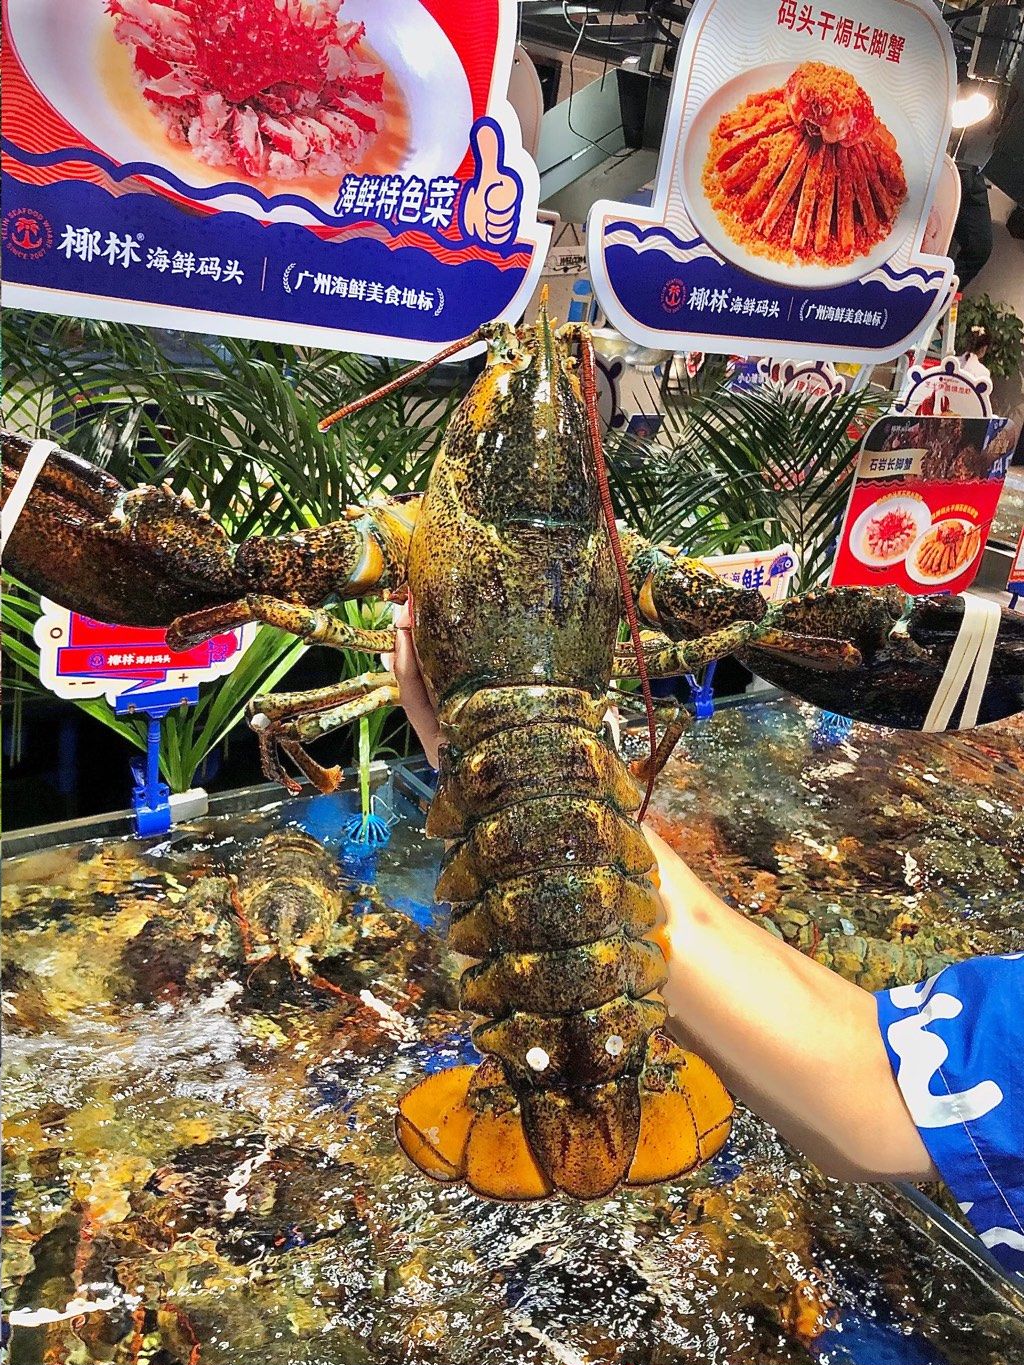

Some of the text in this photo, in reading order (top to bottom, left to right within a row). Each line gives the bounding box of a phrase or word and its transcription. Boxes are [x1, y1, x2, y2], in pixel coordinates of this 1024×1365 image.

[339, 176, 460, 229] 海鲜特色菜
[57, 224, 435, 313] 椰林 海鲜码头 广州海鲜美食地标
[729, 297, 780, 319] 海鲜码头
[804, 303, 883, 328] 广州海鲜美食地标
